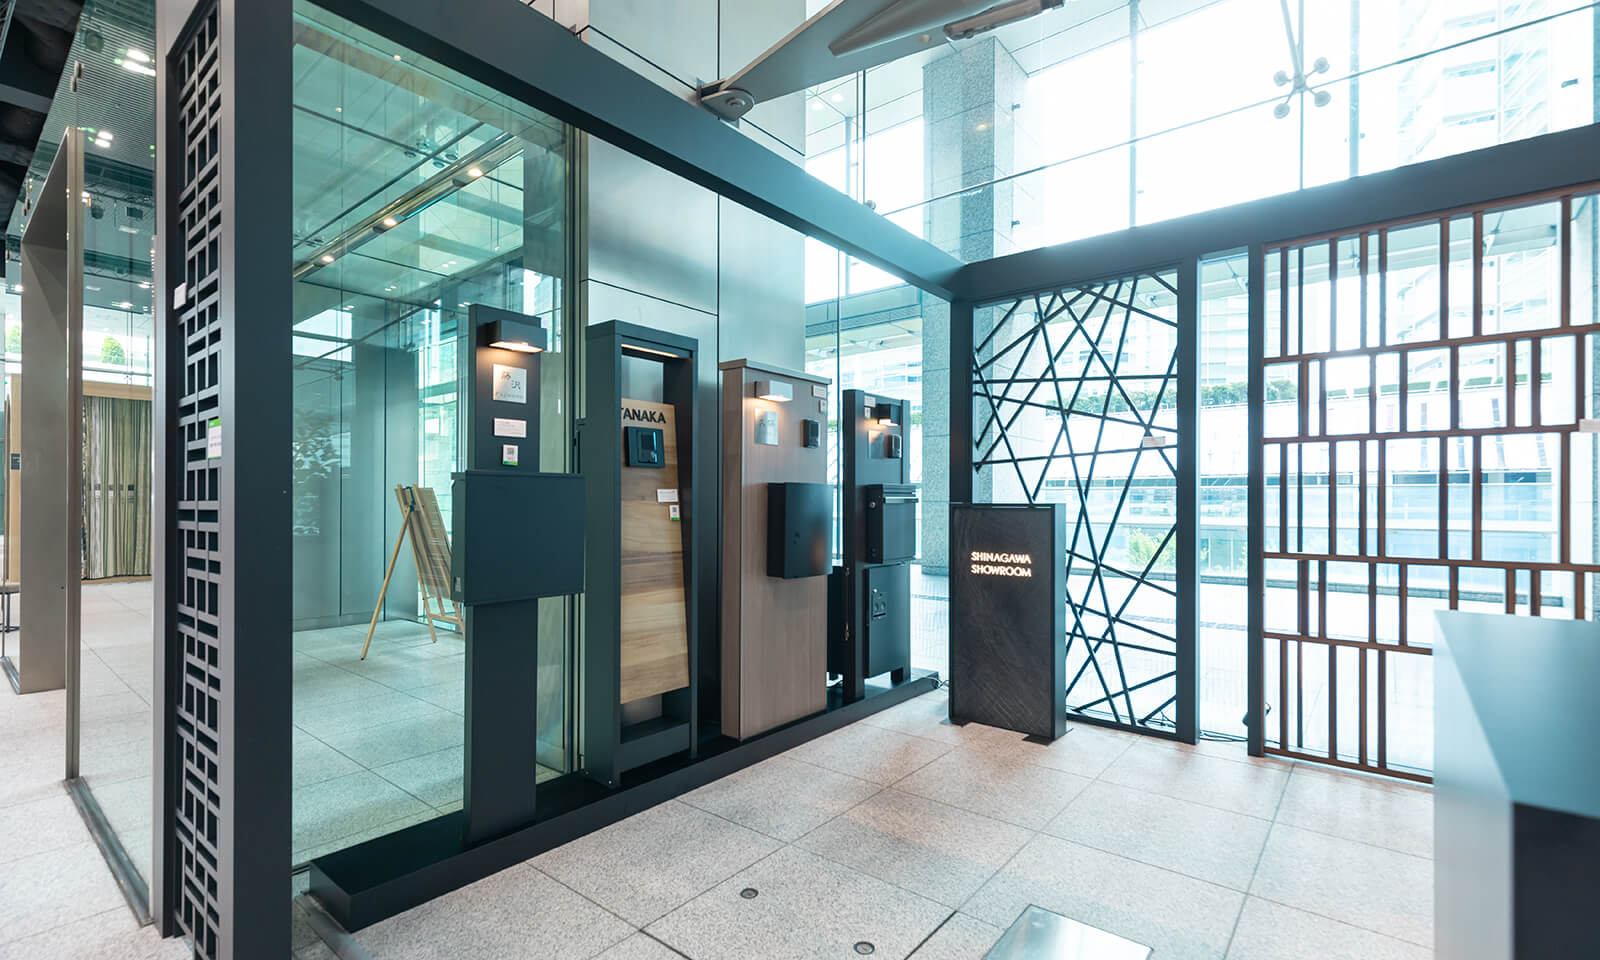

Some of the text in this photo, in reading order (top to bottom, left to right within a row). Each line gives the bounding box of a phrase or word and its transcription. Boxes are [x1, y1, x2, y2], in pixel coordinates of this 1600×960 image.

[621, 408, 666, 424] ANAKA
[971, 551, 1032, 564] SHINAGAWA
[971, 564, 1032, 577] SHOWROOM
